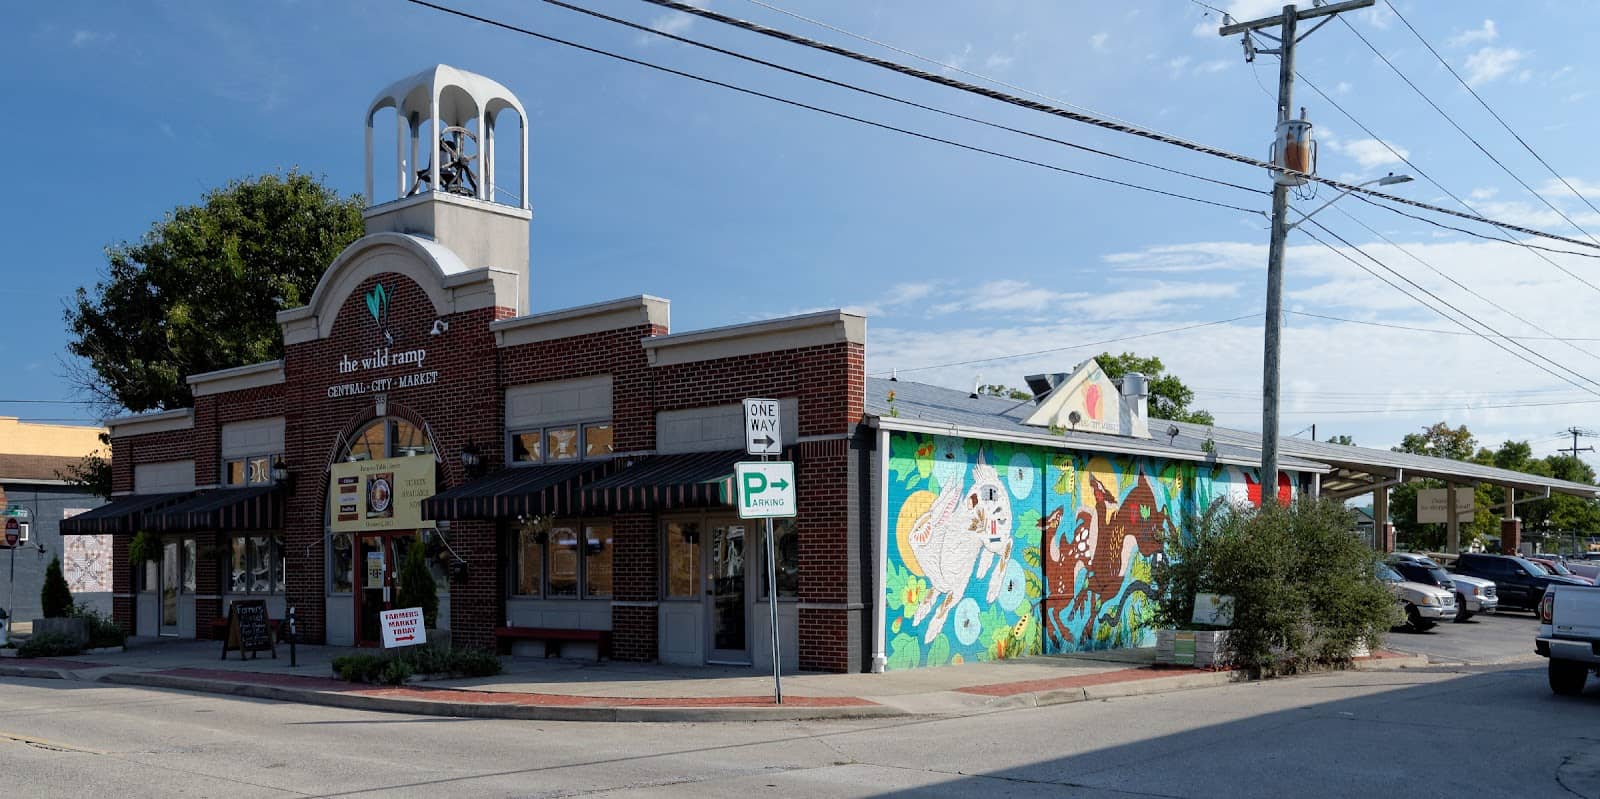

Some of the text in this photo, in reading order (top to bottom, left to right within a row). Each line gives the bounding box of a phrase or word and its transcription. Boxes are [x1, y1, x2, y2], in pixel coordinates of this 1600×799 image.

[339, 347, 426, 373] the wild ramp
[327, 371, 438, 398] CENTRAL CITY MARKET
[750, 404, 775, 417] ONE
[751, 419, 776, 432] WAY
[385, 611, 419, 620] FARMERS
[389, 619, 417, 627] MARKET
[393, 627, 416, 635] TODAY
